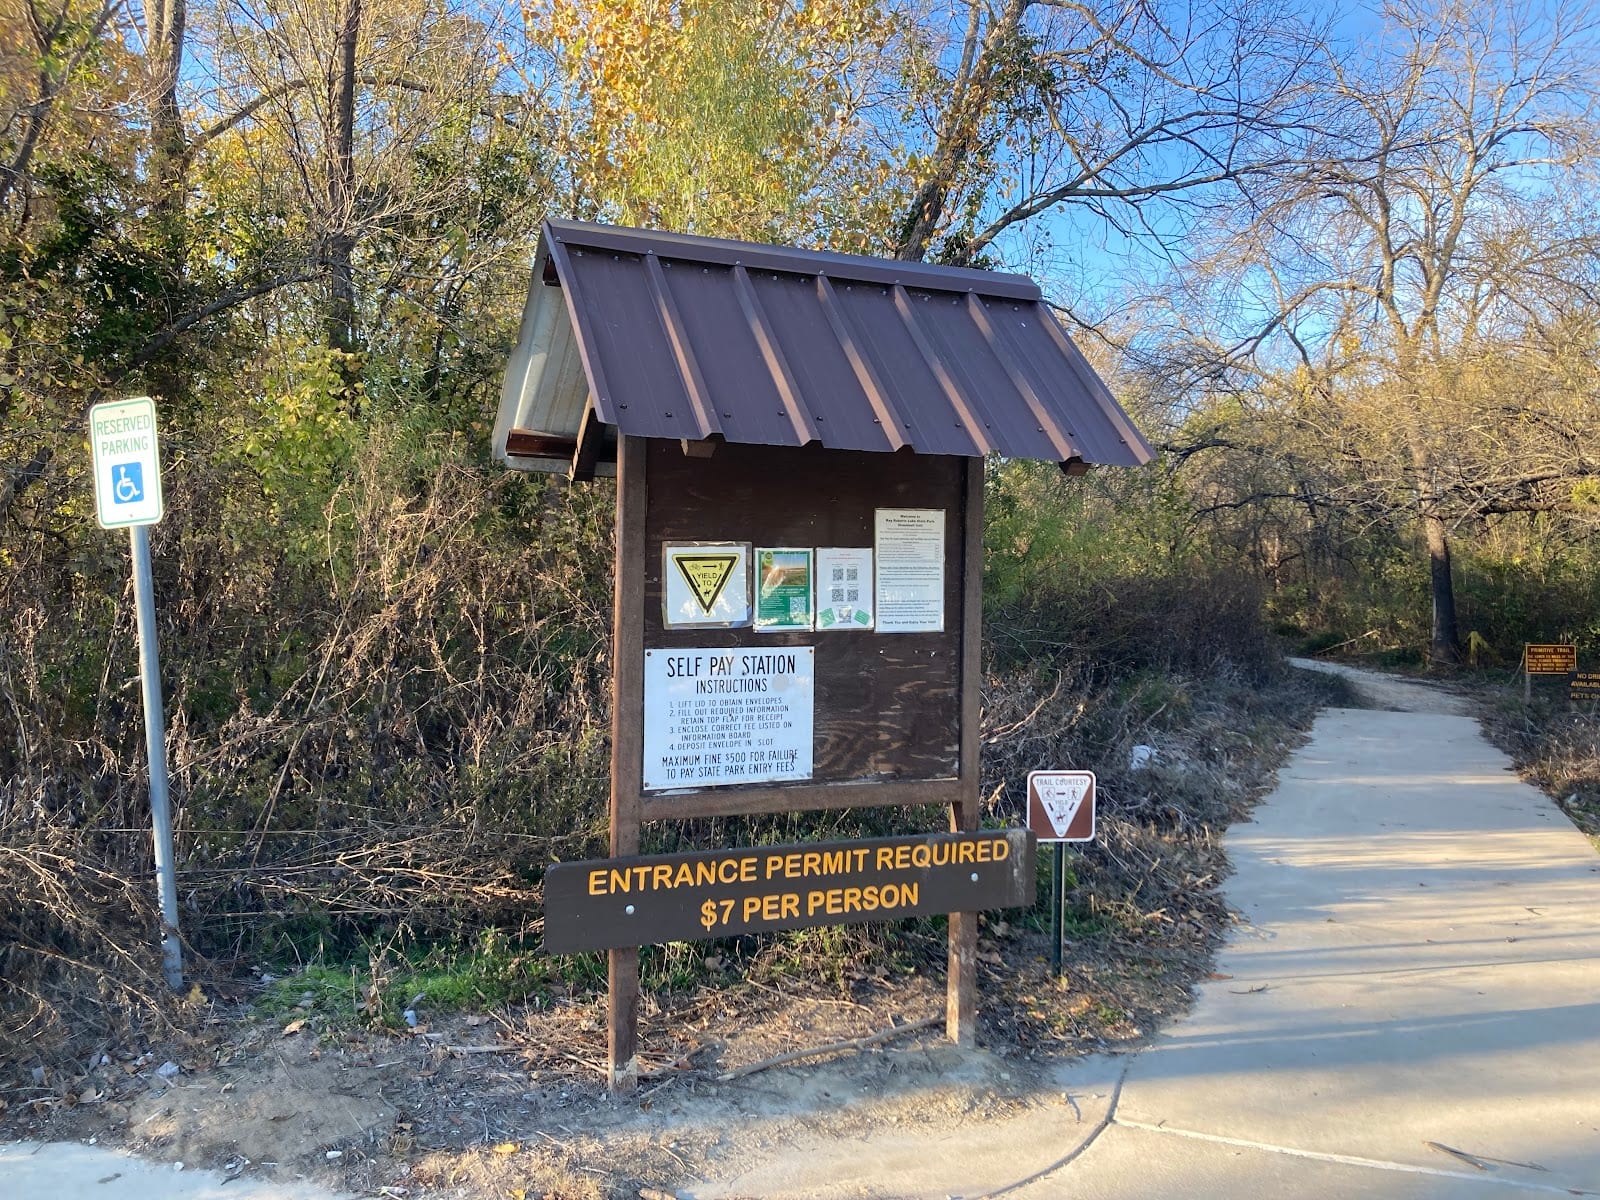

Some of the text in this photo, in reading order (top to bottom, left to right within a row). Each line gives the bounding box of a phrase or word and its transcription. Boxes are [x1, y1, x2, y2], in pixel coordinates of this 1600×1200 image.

[96, 414, 151, 436] RESERVED
[101, 435, 149, 456] PARKING
[667, 654, 796, 678] SELF PAY STATION
[696, 678, 768, 695] INSTRUCTIONS
[677, 700, 692, 708] LIFT
[694, 700, 706, 708] LID
[719, 698, 743, 706] OBTAIN
[745, 697, 783, 706] ENVELOPES
[677, 708, 692, 717] FILL
[694, 708, 708, 716] OUT
[710, 706, 744, 716] REQUIRED
[746, 704, 789, 714] INFORMATION
[677, 725, 708, 734] ENCLOSE
[711, 723, 741, 732] CORRECT
[744, 722, 756, 731] FEE
[759, 721, 781, 730] LISTED
[783, 721, 793, 729] ON
[680, 713, 784, 725] RETAIN TOP FLAP FOR RECEIPT
[677, 742, 706, 751] DEPOSIT
[708, 740, 742, 749] ENVELOPE
[745, 739, 752, 747] IN
[758, 737, 774, 746] SLOT
[681, 731, 751, 742] INFORMATION BOARD
[661, 748, 799, 768] MAXIMUM FINE $500 FOR FAILURE
[666, 761, 796, 780] TO PAY STATE PARK ENTRY FEES
[1036, 778, 1088, 786] TRAIL COURTESY
[588, 839, 1010, 896] ENTRANCE PERMIT REQUIRED
[700, 882, 919, 932] $7 PER PERSON
